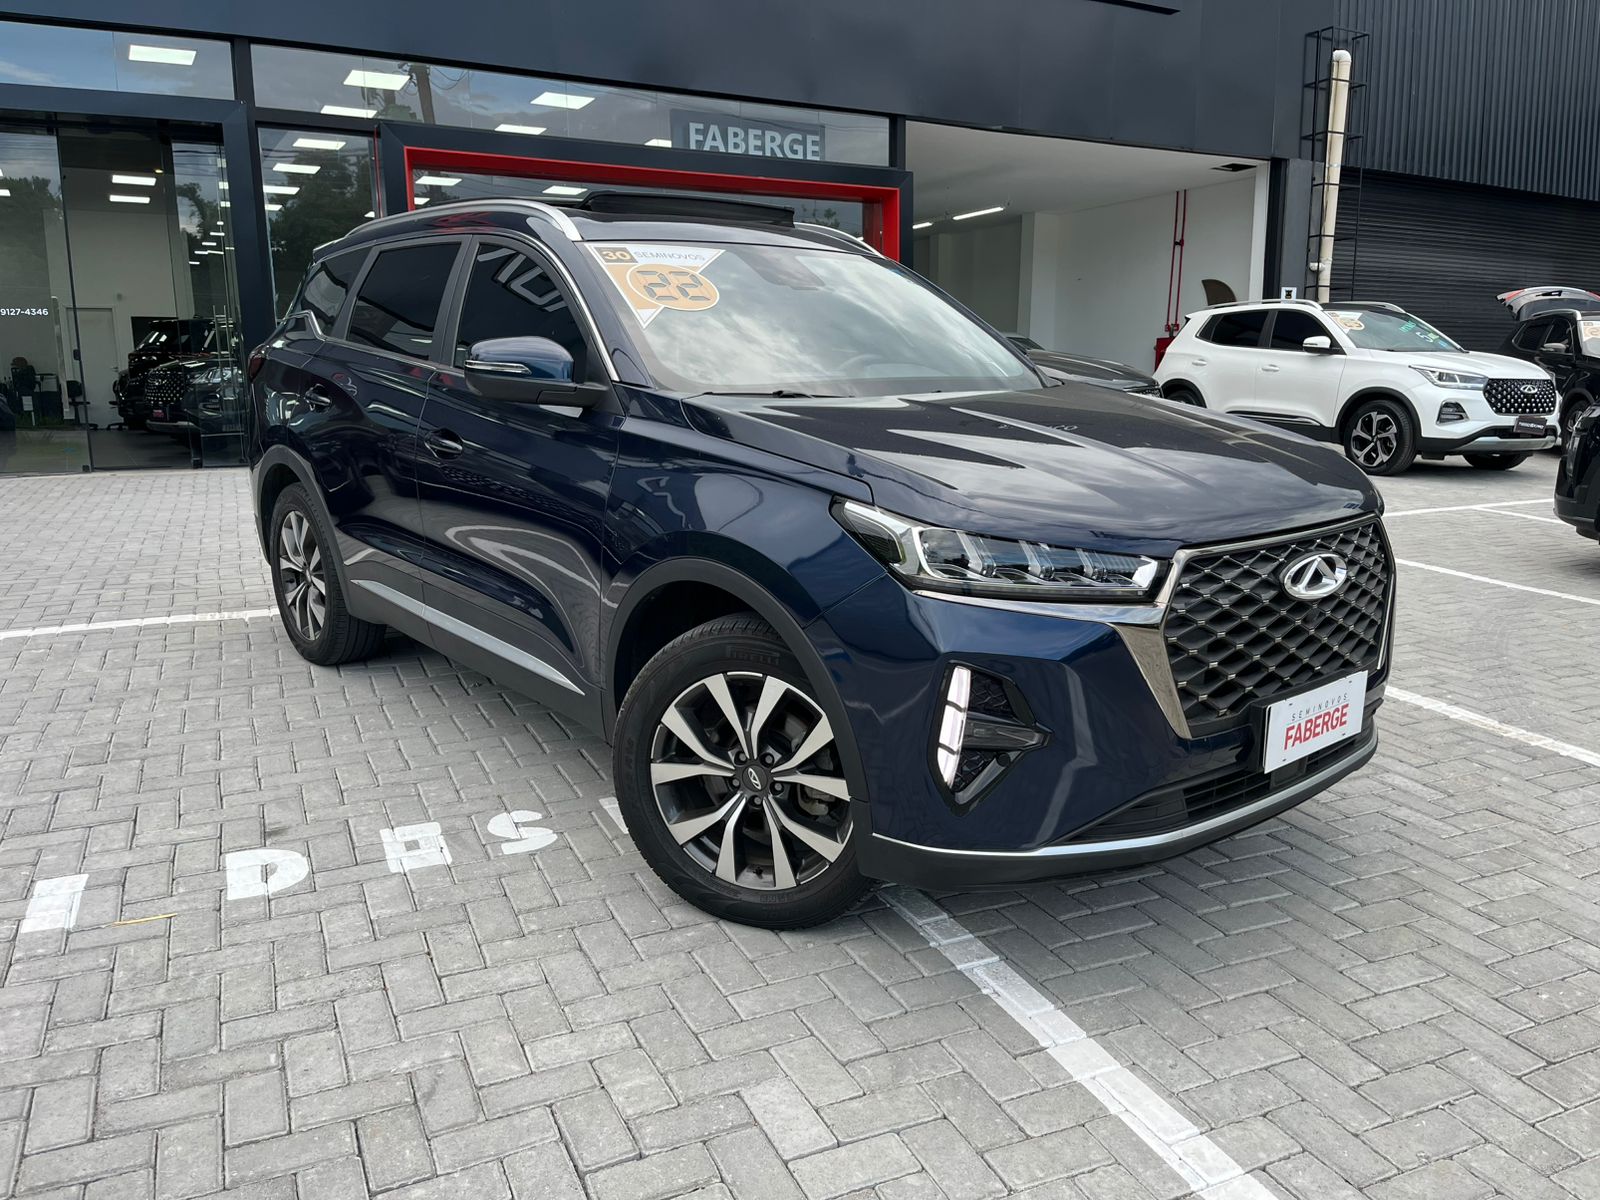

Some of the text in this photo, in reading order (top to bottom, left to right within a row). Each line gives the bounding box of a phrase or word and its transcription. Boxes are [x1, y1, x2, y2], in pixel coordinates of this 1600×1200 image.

[688, 122, 821, 161] FABERGE
[601, 250, 705, 261] 30 SEMINOVOS
[636, 270, 711, 301] 22
[0, 308, 49, 316] 9127-4346
[1291, 692, 1348, 721] SEMINOVOS
[1283, 703, 1349, 751] FABERGE
